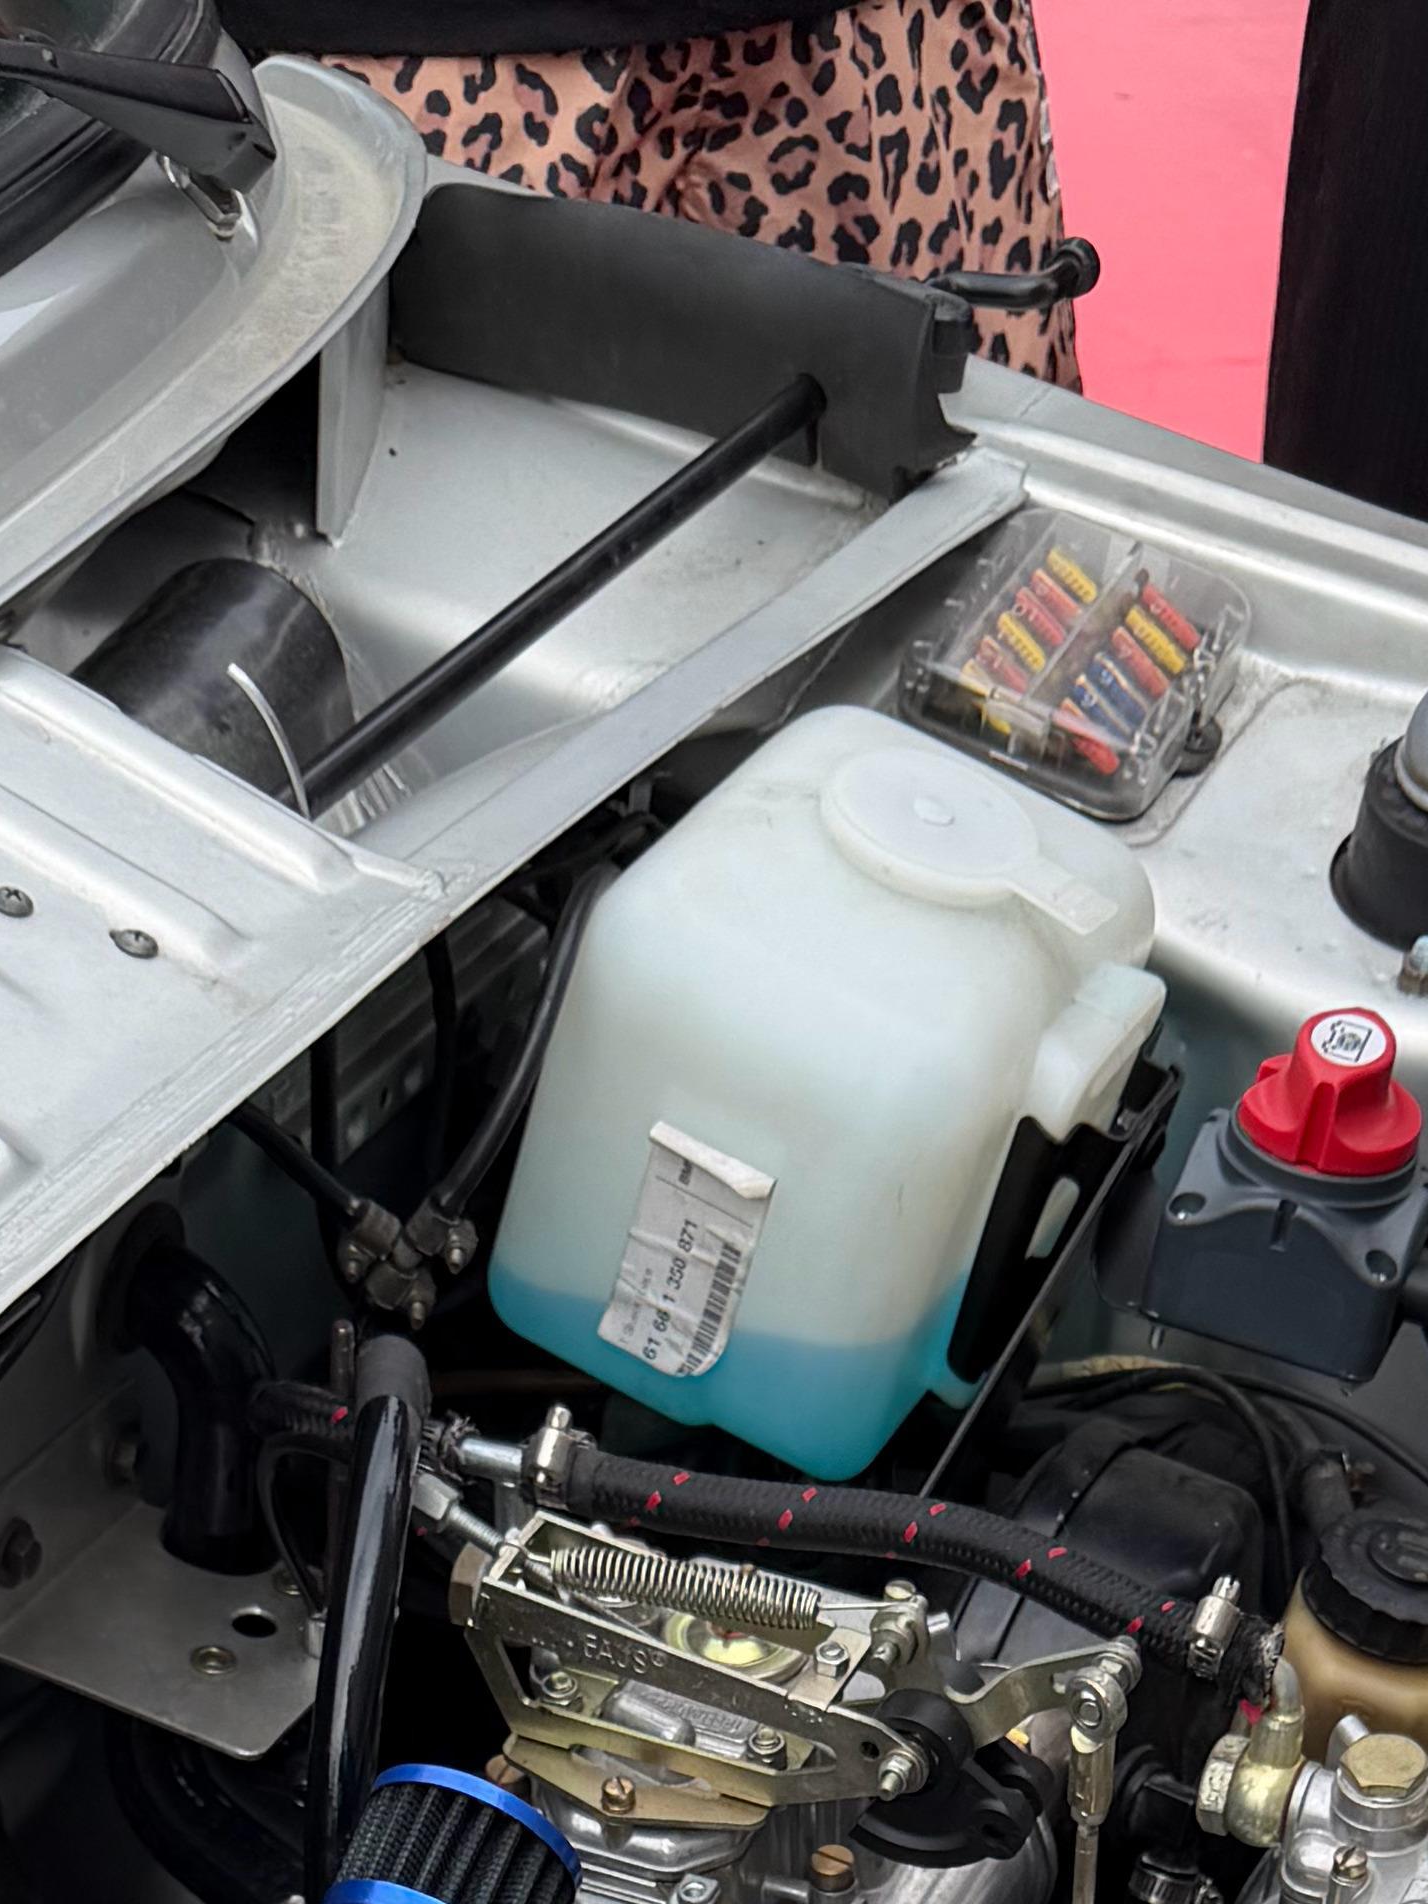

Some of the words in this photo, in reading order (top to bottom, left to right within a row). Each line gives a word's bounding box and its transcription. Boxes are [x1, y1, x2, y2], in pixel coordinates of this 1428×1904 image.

[677, 1218, 699, 1253] 871
[665, 1256, 687, 1291] 350
[662, 1292, 677, 1305] 1
[642, 1335, 662, 1361] 61
